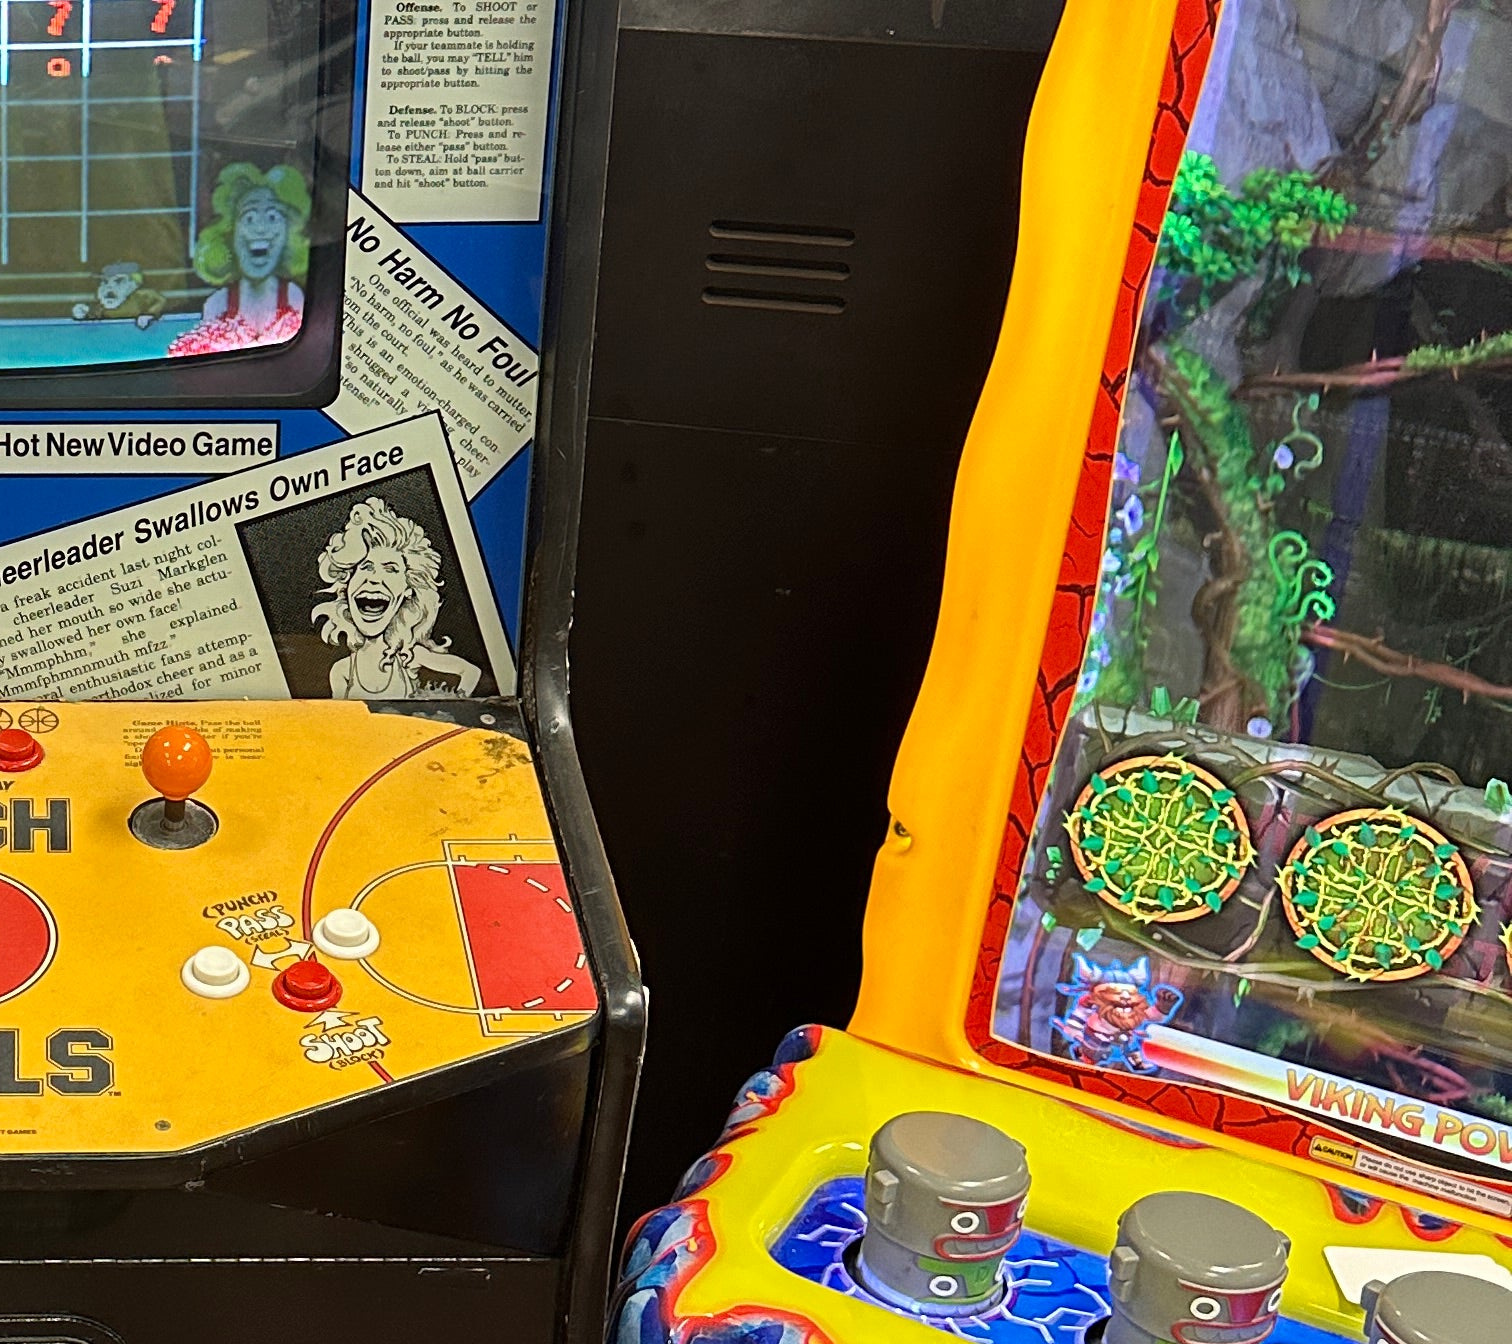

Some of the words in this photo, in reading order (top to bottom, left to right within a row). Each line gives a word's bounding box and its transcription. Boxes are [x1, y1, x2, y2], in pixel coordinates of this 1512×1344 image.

[46, 1, 72, 37] 7
[348, 216, 381, 253] No
[378, 248, 446, 310] Harm
[442, 304, 481, 341] No
[477, 335, 539, 388] Foul
[46, 432, 104, 457] New
[107, 432, 187, 457] Video
[192, 431, 273, 457] Game
[134, 489, 260, 545] Swallows
[269, 466, 329, 502] Own
[339, 444, 405, 482] Face
[0, 602, 9, 613] a
[13, 587, 52, 609] freak
[58, 568, 116, 596] accident
[120, 556, 151, 576] last
[154, 543, 193, 569] night
[197, 535, 223, 552] col-
[202, 890, 278, 919] (PUNCH)
[216, 905, 296, 940] PASS
[299, 1016, 391, 1064] SHOOT
[329, 1048, 386, 1071] (BLOCK)
[1286, 1068, 1426, 1137] VIKING
